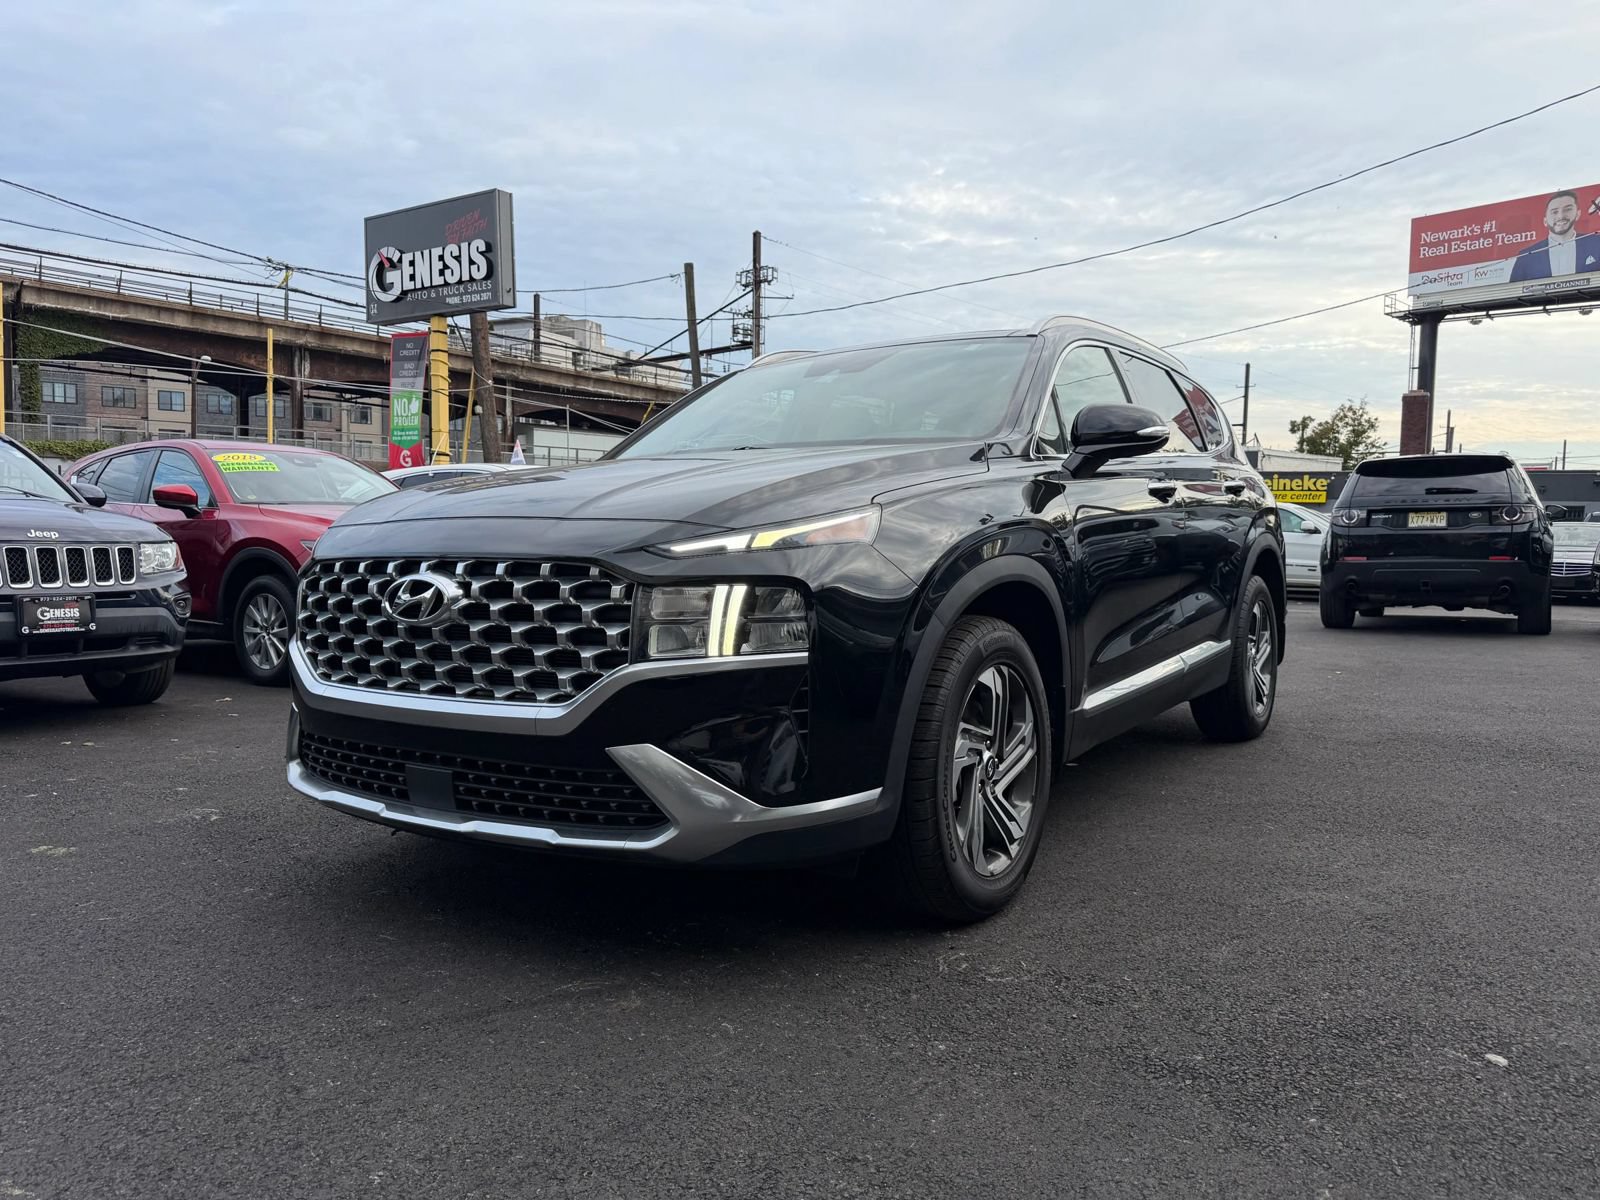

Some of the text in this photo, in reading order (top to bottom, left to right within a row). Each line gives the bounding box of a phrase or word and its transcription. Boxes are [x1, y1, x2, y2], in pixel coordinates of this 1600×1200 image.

[1420, 220, 1497, 244] Newark's #1
[1419, 230, 1537, 258] Real Estate Team
[368, 238, 488, 303] GENESIS
[406, 280, 492, 302] AUTO & TRUCK SALES
[400, 449, 412, 467] G
[1264, 473, 1328, 491] eineke
[1290, 492, 1322, 501] center
[27, 529, 59, 539] Jeep
[36, 606, 80, 620] GENESIS
[21, 626, 30, 634] G
[89, 622, 97, 631] G
